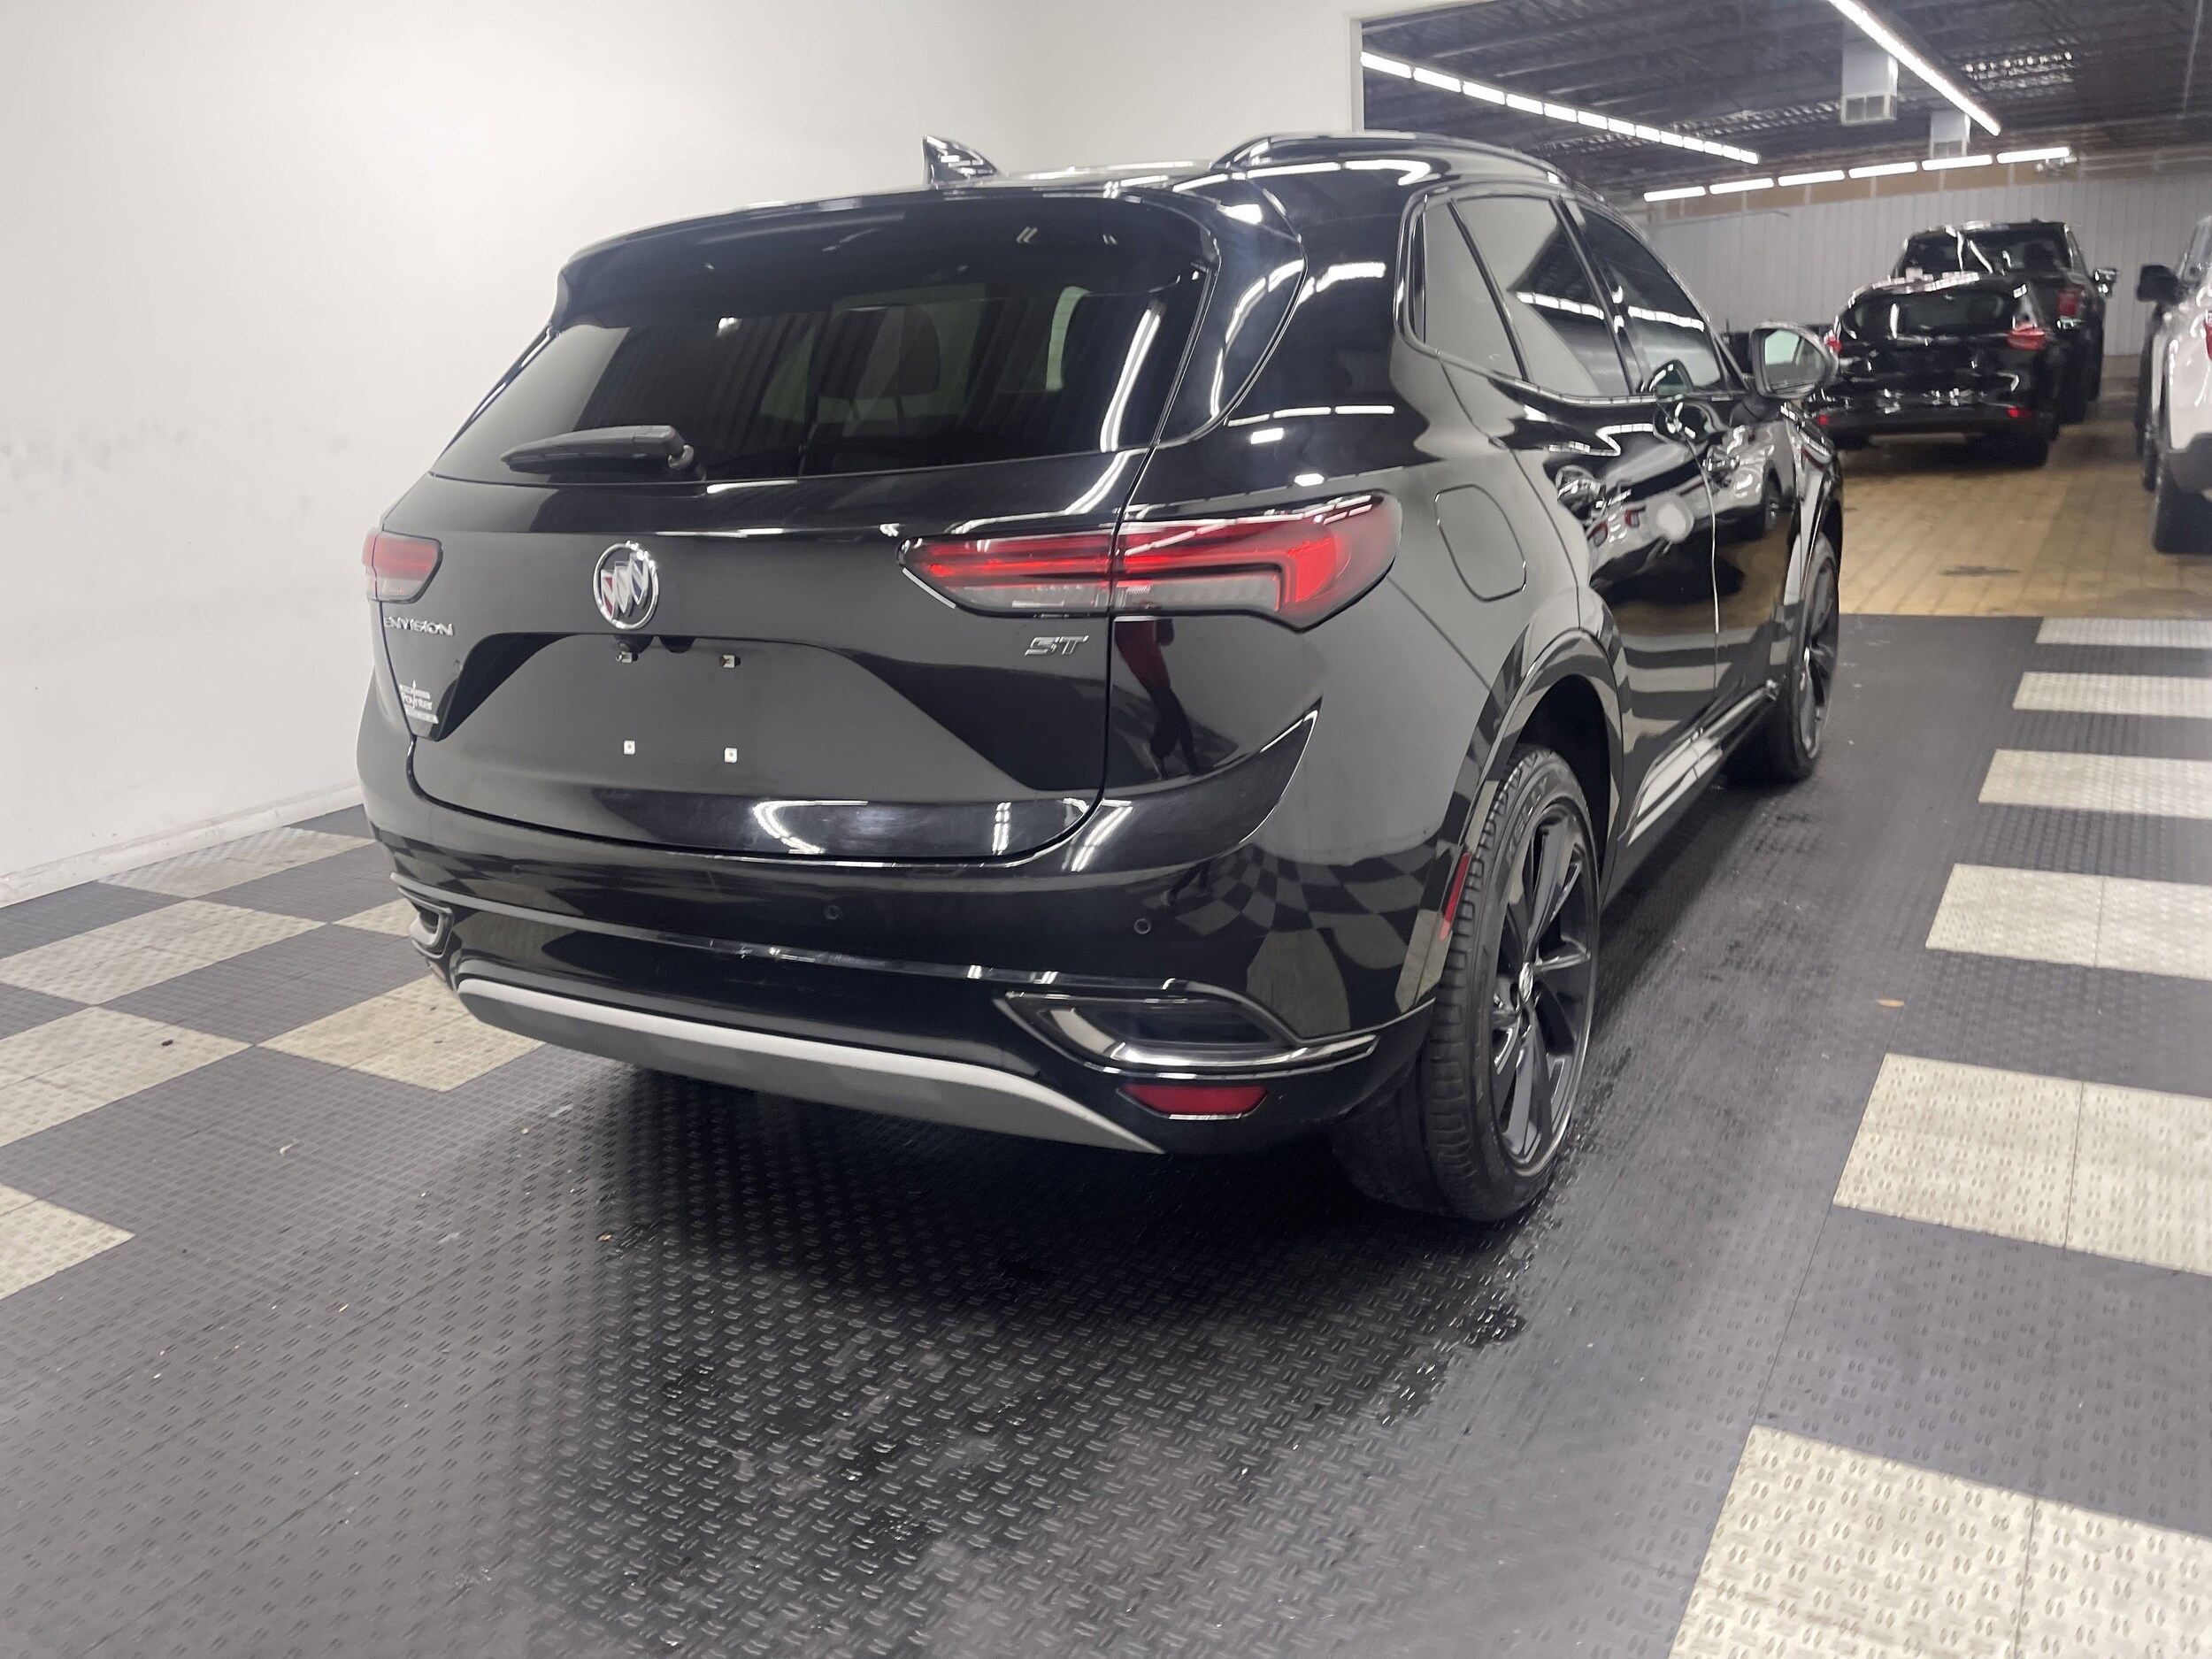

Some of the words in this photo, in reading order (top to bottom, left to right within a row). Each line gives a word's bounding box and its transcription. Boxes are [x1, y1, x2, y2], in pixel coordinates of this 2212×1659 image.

[384, 616, 454, 636] ENVISION
[1025, 635, 1089, 656] ST
[1505, 777, 1548, 868] KELLY
